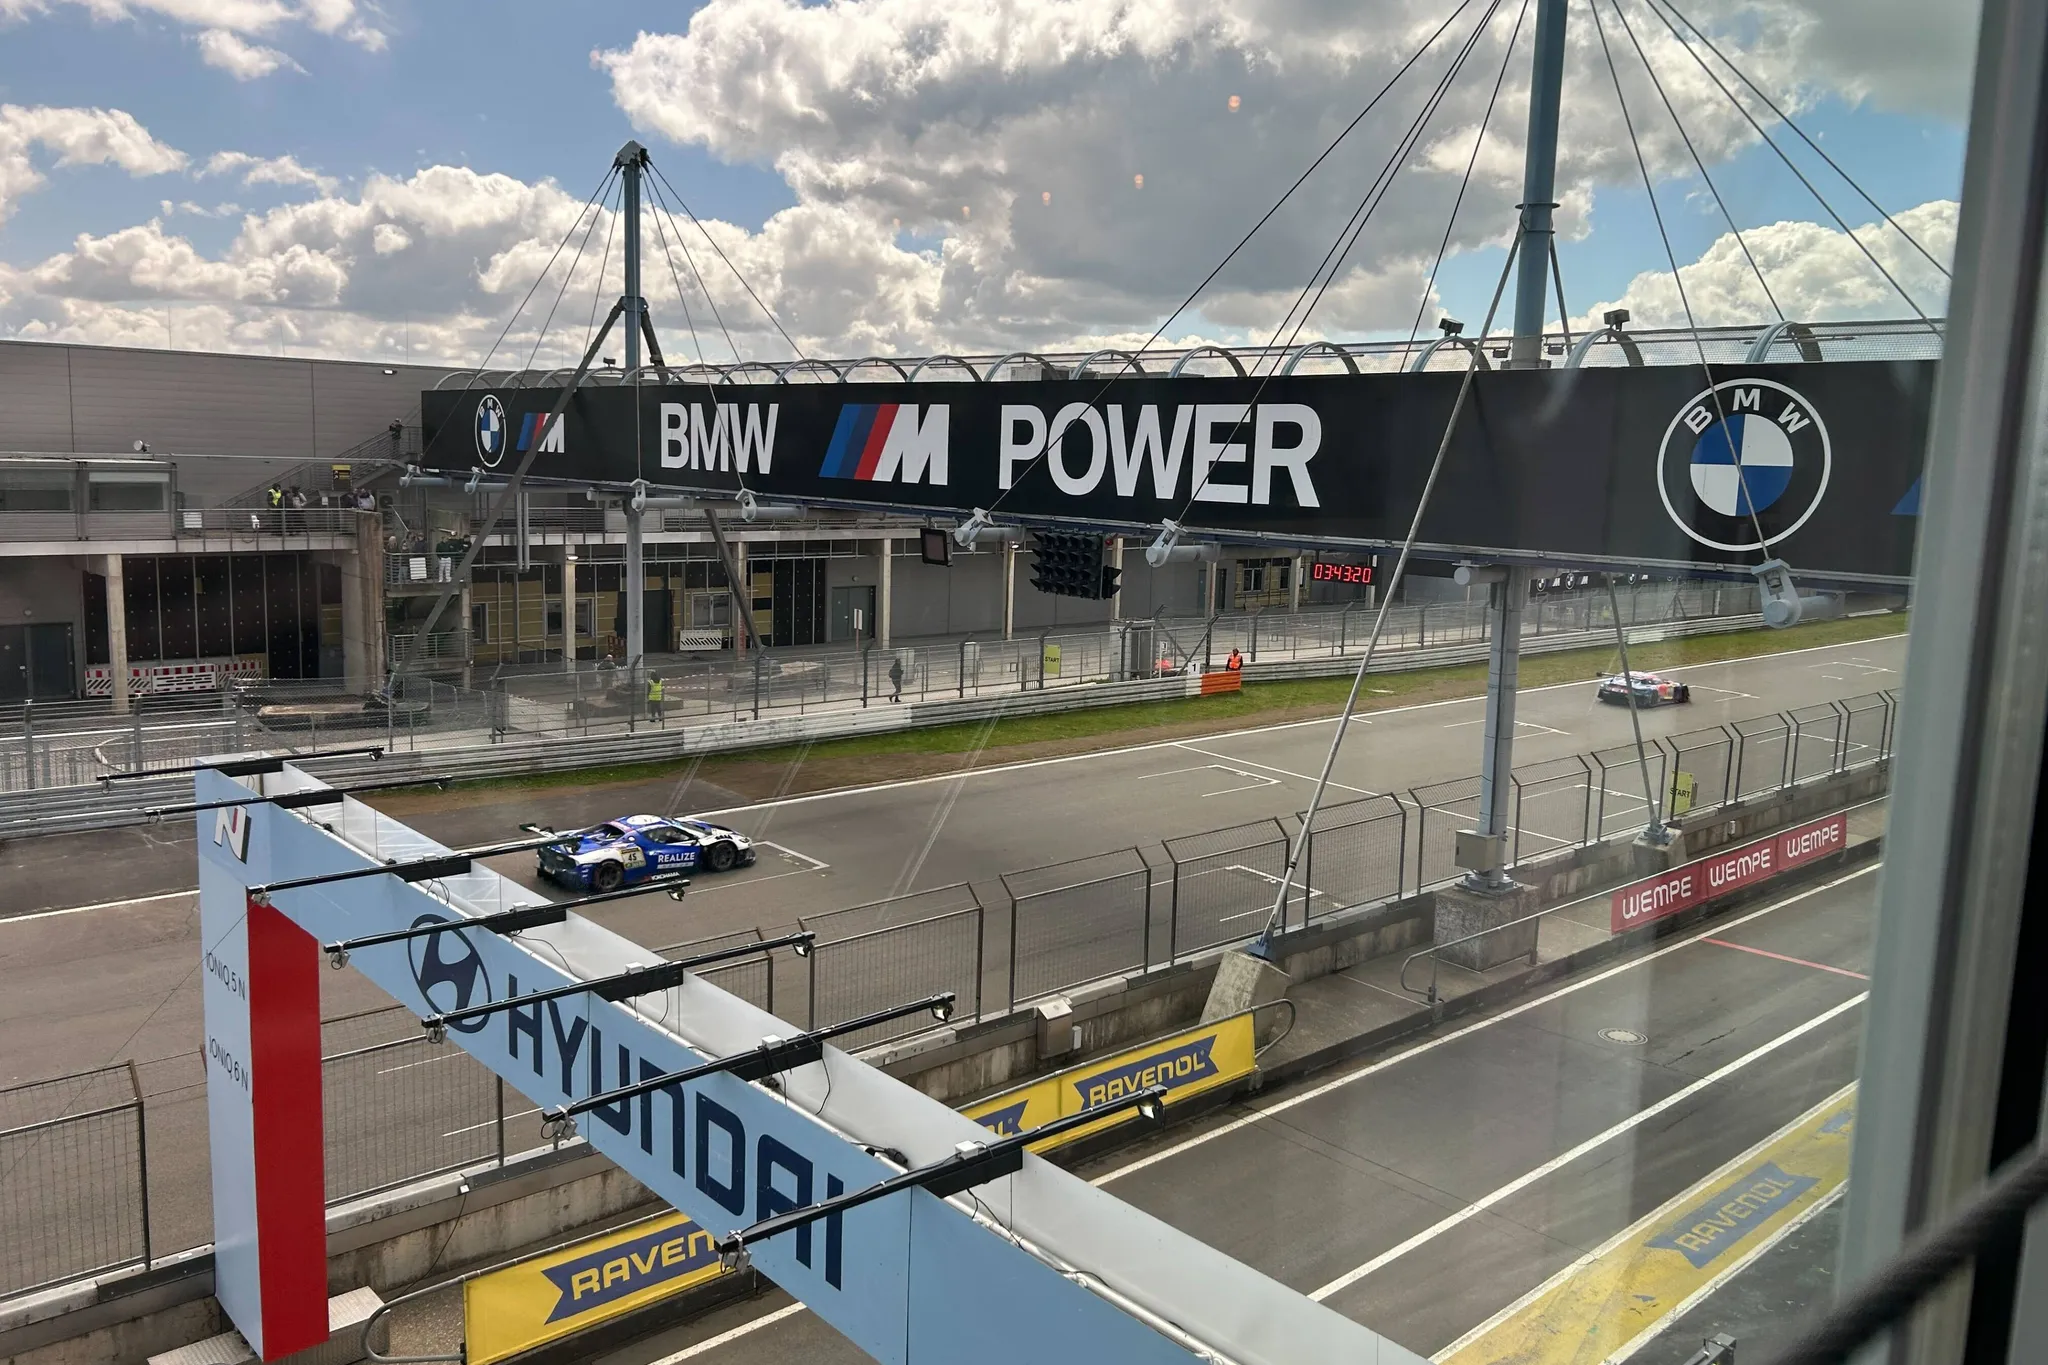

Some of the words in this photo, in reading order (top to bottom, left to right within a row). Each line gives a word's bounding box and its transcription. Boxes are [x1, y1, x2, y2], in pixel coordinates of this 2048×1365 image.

[479, 398, 502, 418] BMW
[1683, 386, 1810, 435] BMW
[660, 402, 779, 475] BMW
[998, 402, 1322, 508] POWER
[1314, 563, 1372, 583] 03:43:20
[1045, 656, 1060, 664] START
[657, 851, 695, 863] REALIZE
[1787, 823, 1839, 858] WEMPE
[1710, 848, 1771, 888] WEMPE
[1622, 875, 1692, 920] WEMPE
[1089, 1050, 1206, 1108] RAVENOL
[508, 973, 844, 1291] HYUNDAI
[1674, 1177, 1795, 1252] RAVENOL
[571, 1232, 714, 1300] RAVEN
